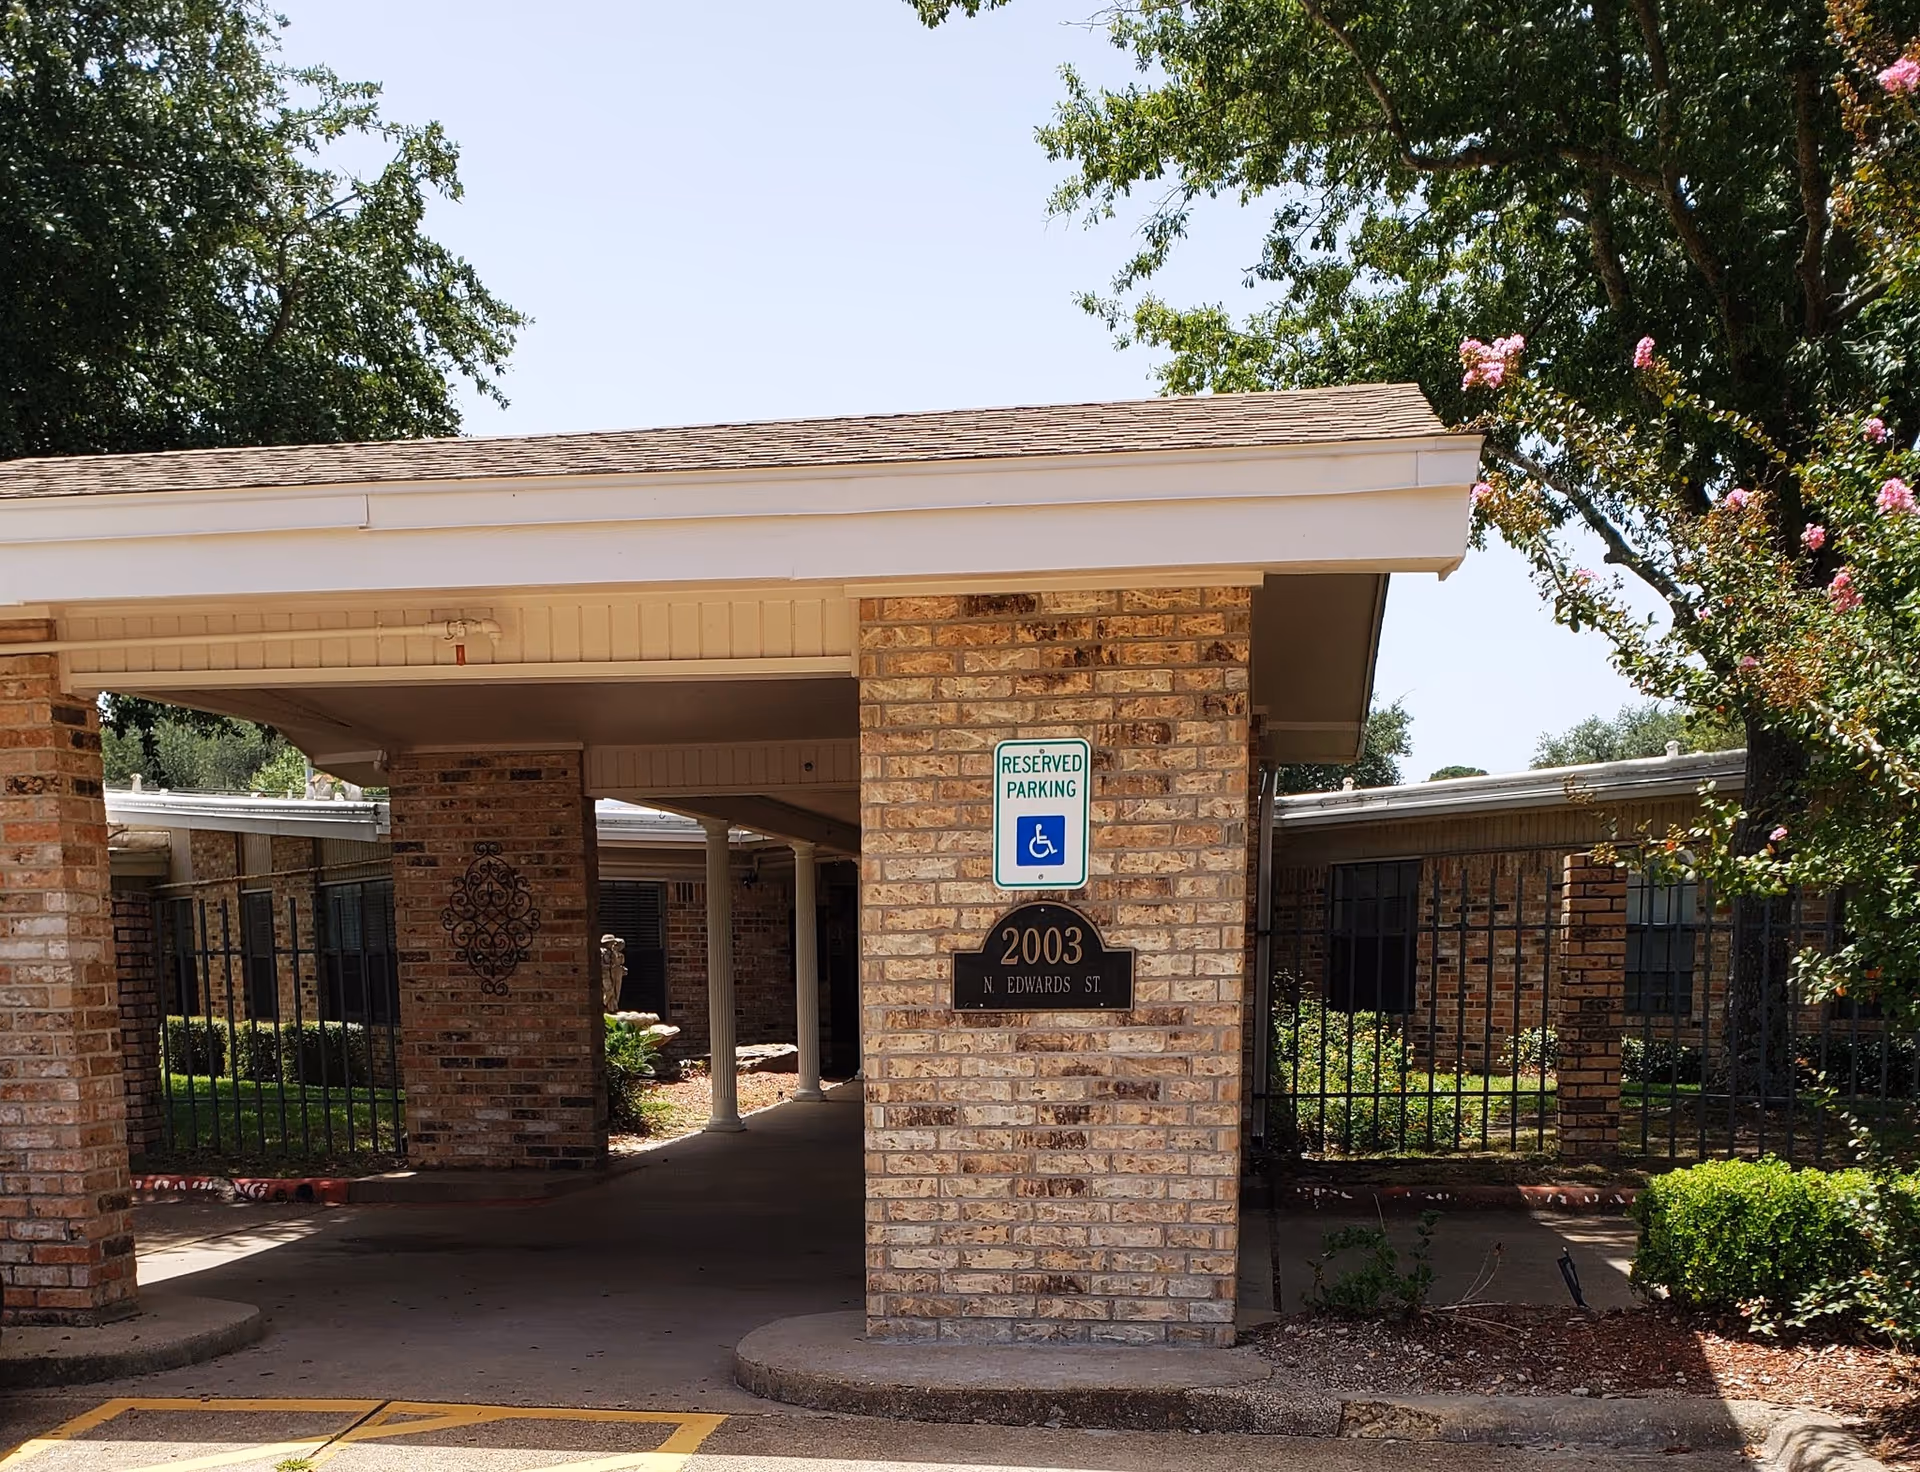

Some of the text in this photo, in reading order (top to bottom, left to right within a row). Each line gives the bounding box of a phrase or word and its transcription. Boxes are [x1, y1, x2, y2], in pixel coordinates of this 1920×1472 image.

[1002, 754, 1082, 774] RESERVED
[1007, 780, 1076, 798] PARKING
[1001, 926, 1083, 965] 2003
[1007, 976, 1071, 994] EDWARDS
